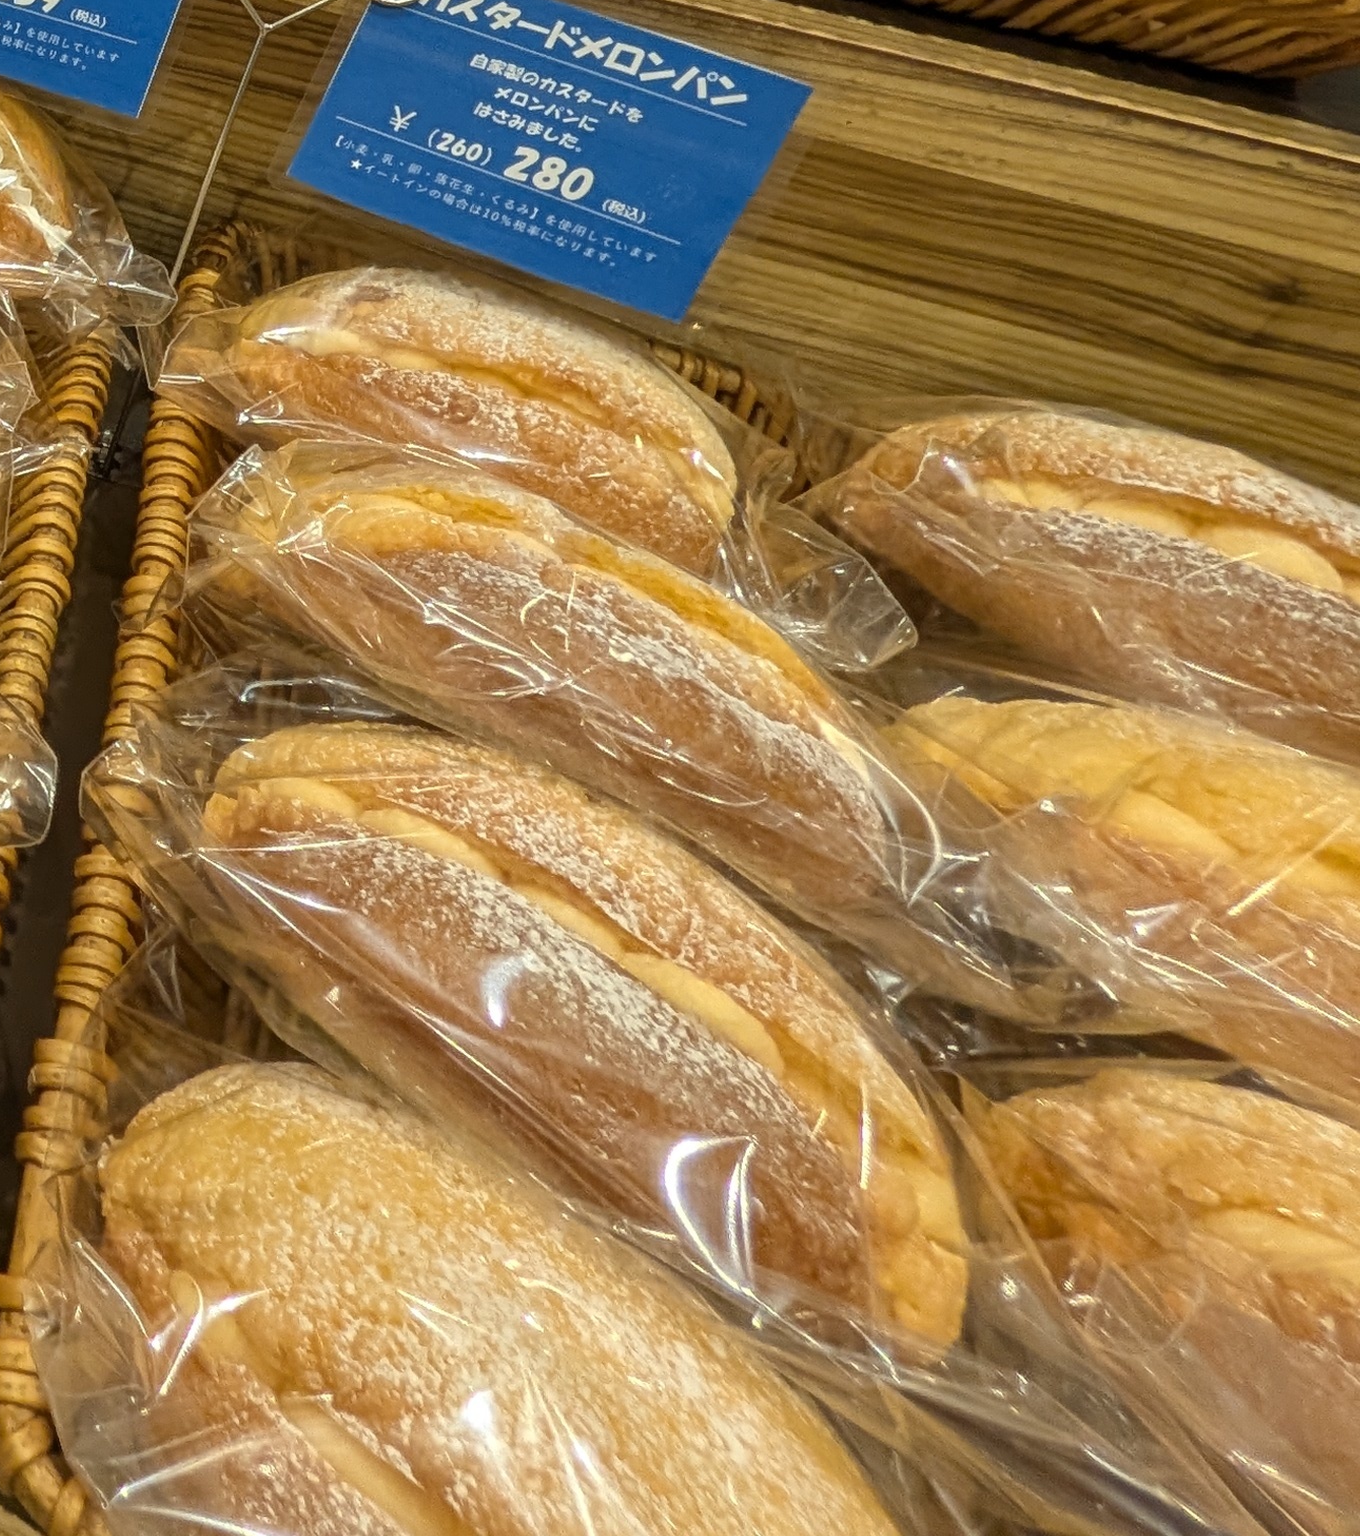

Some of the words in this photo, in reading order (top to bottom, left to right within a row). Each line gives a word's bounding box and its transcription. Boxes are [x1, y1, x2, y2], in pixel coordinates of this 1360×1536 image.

[69, 8, 108, 29] (税込)
[468, 52, 644, 124] 自家製のカスタードを
[493, 86, 597, 133] メロンパンに
[473, 101, 584, 154] はさみました。
[388, 104, 418, 133] ¥
[427, 126, 493, 168] (260)
[503, 145, 596, 202] 280
[601, 196, 647, 225] (税込)
